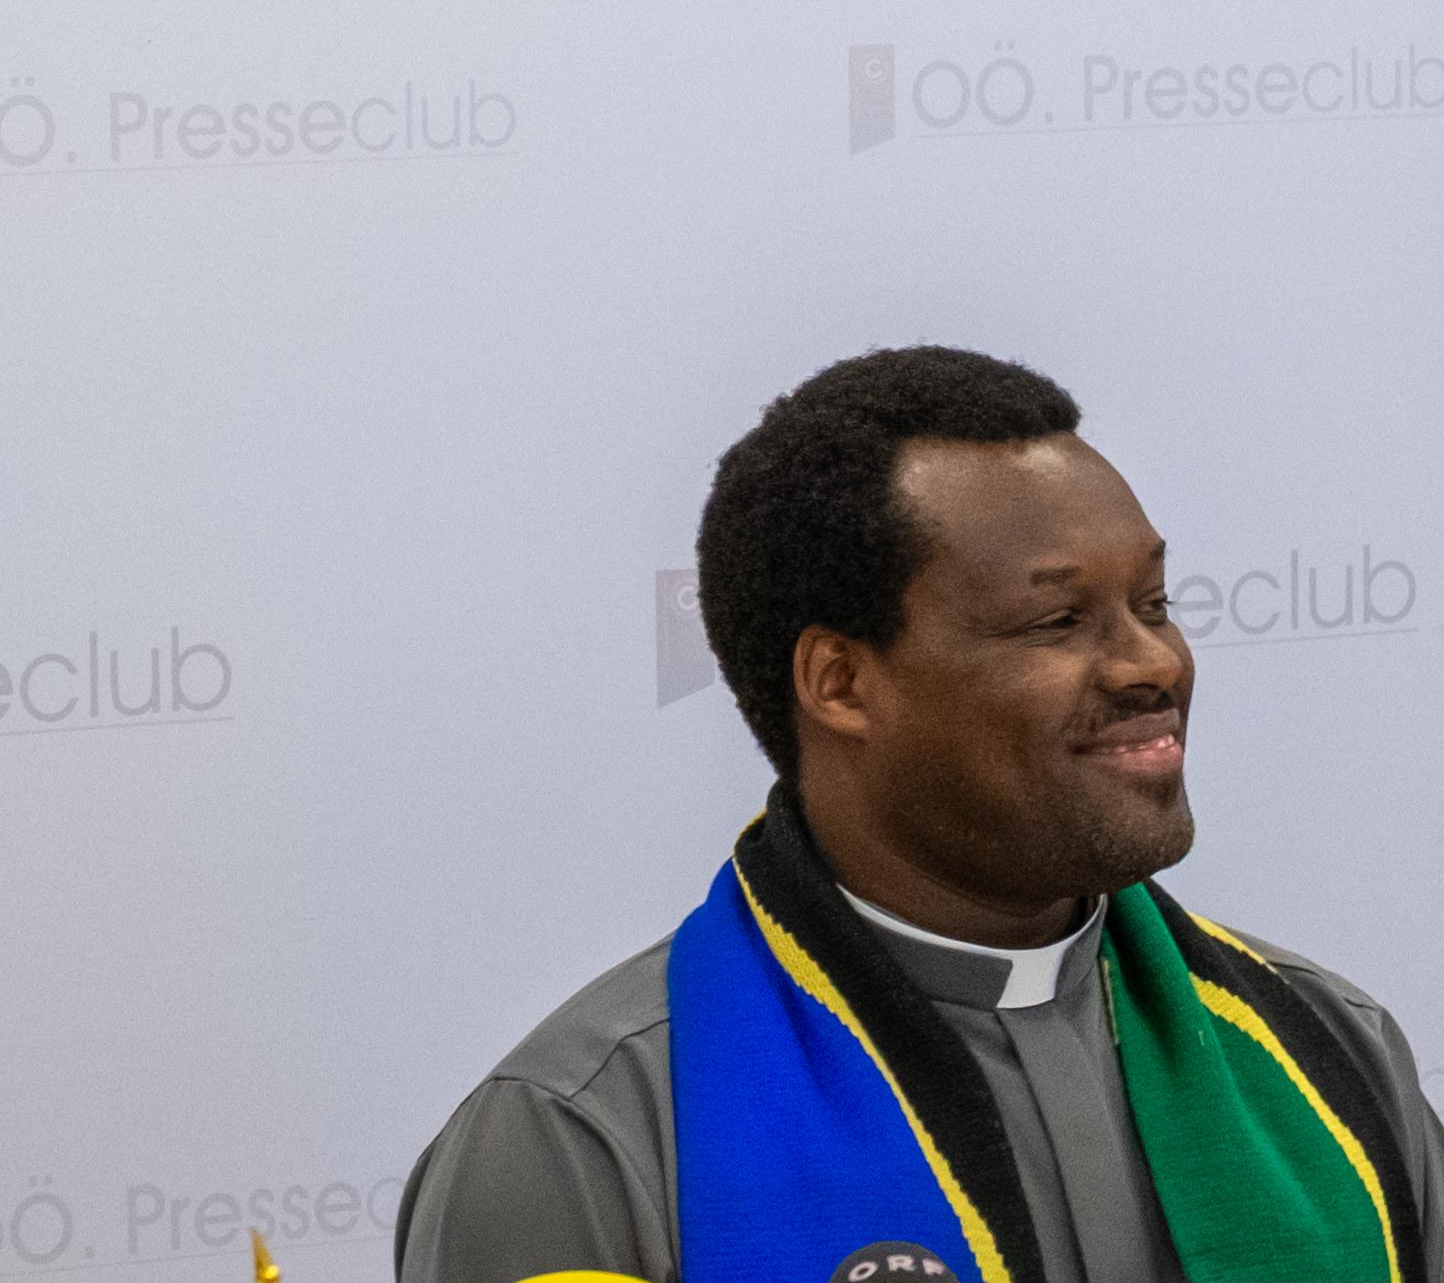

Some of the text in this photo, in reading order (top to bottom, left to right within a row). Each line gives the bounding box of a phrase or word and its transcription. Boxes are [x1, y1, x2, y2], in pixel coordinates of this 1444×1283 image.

[108, 78, 517, 162] Presseclub
[912, 41, 1053, 128] OÖ.
[0, 1176, 96, 1265] Ö.
